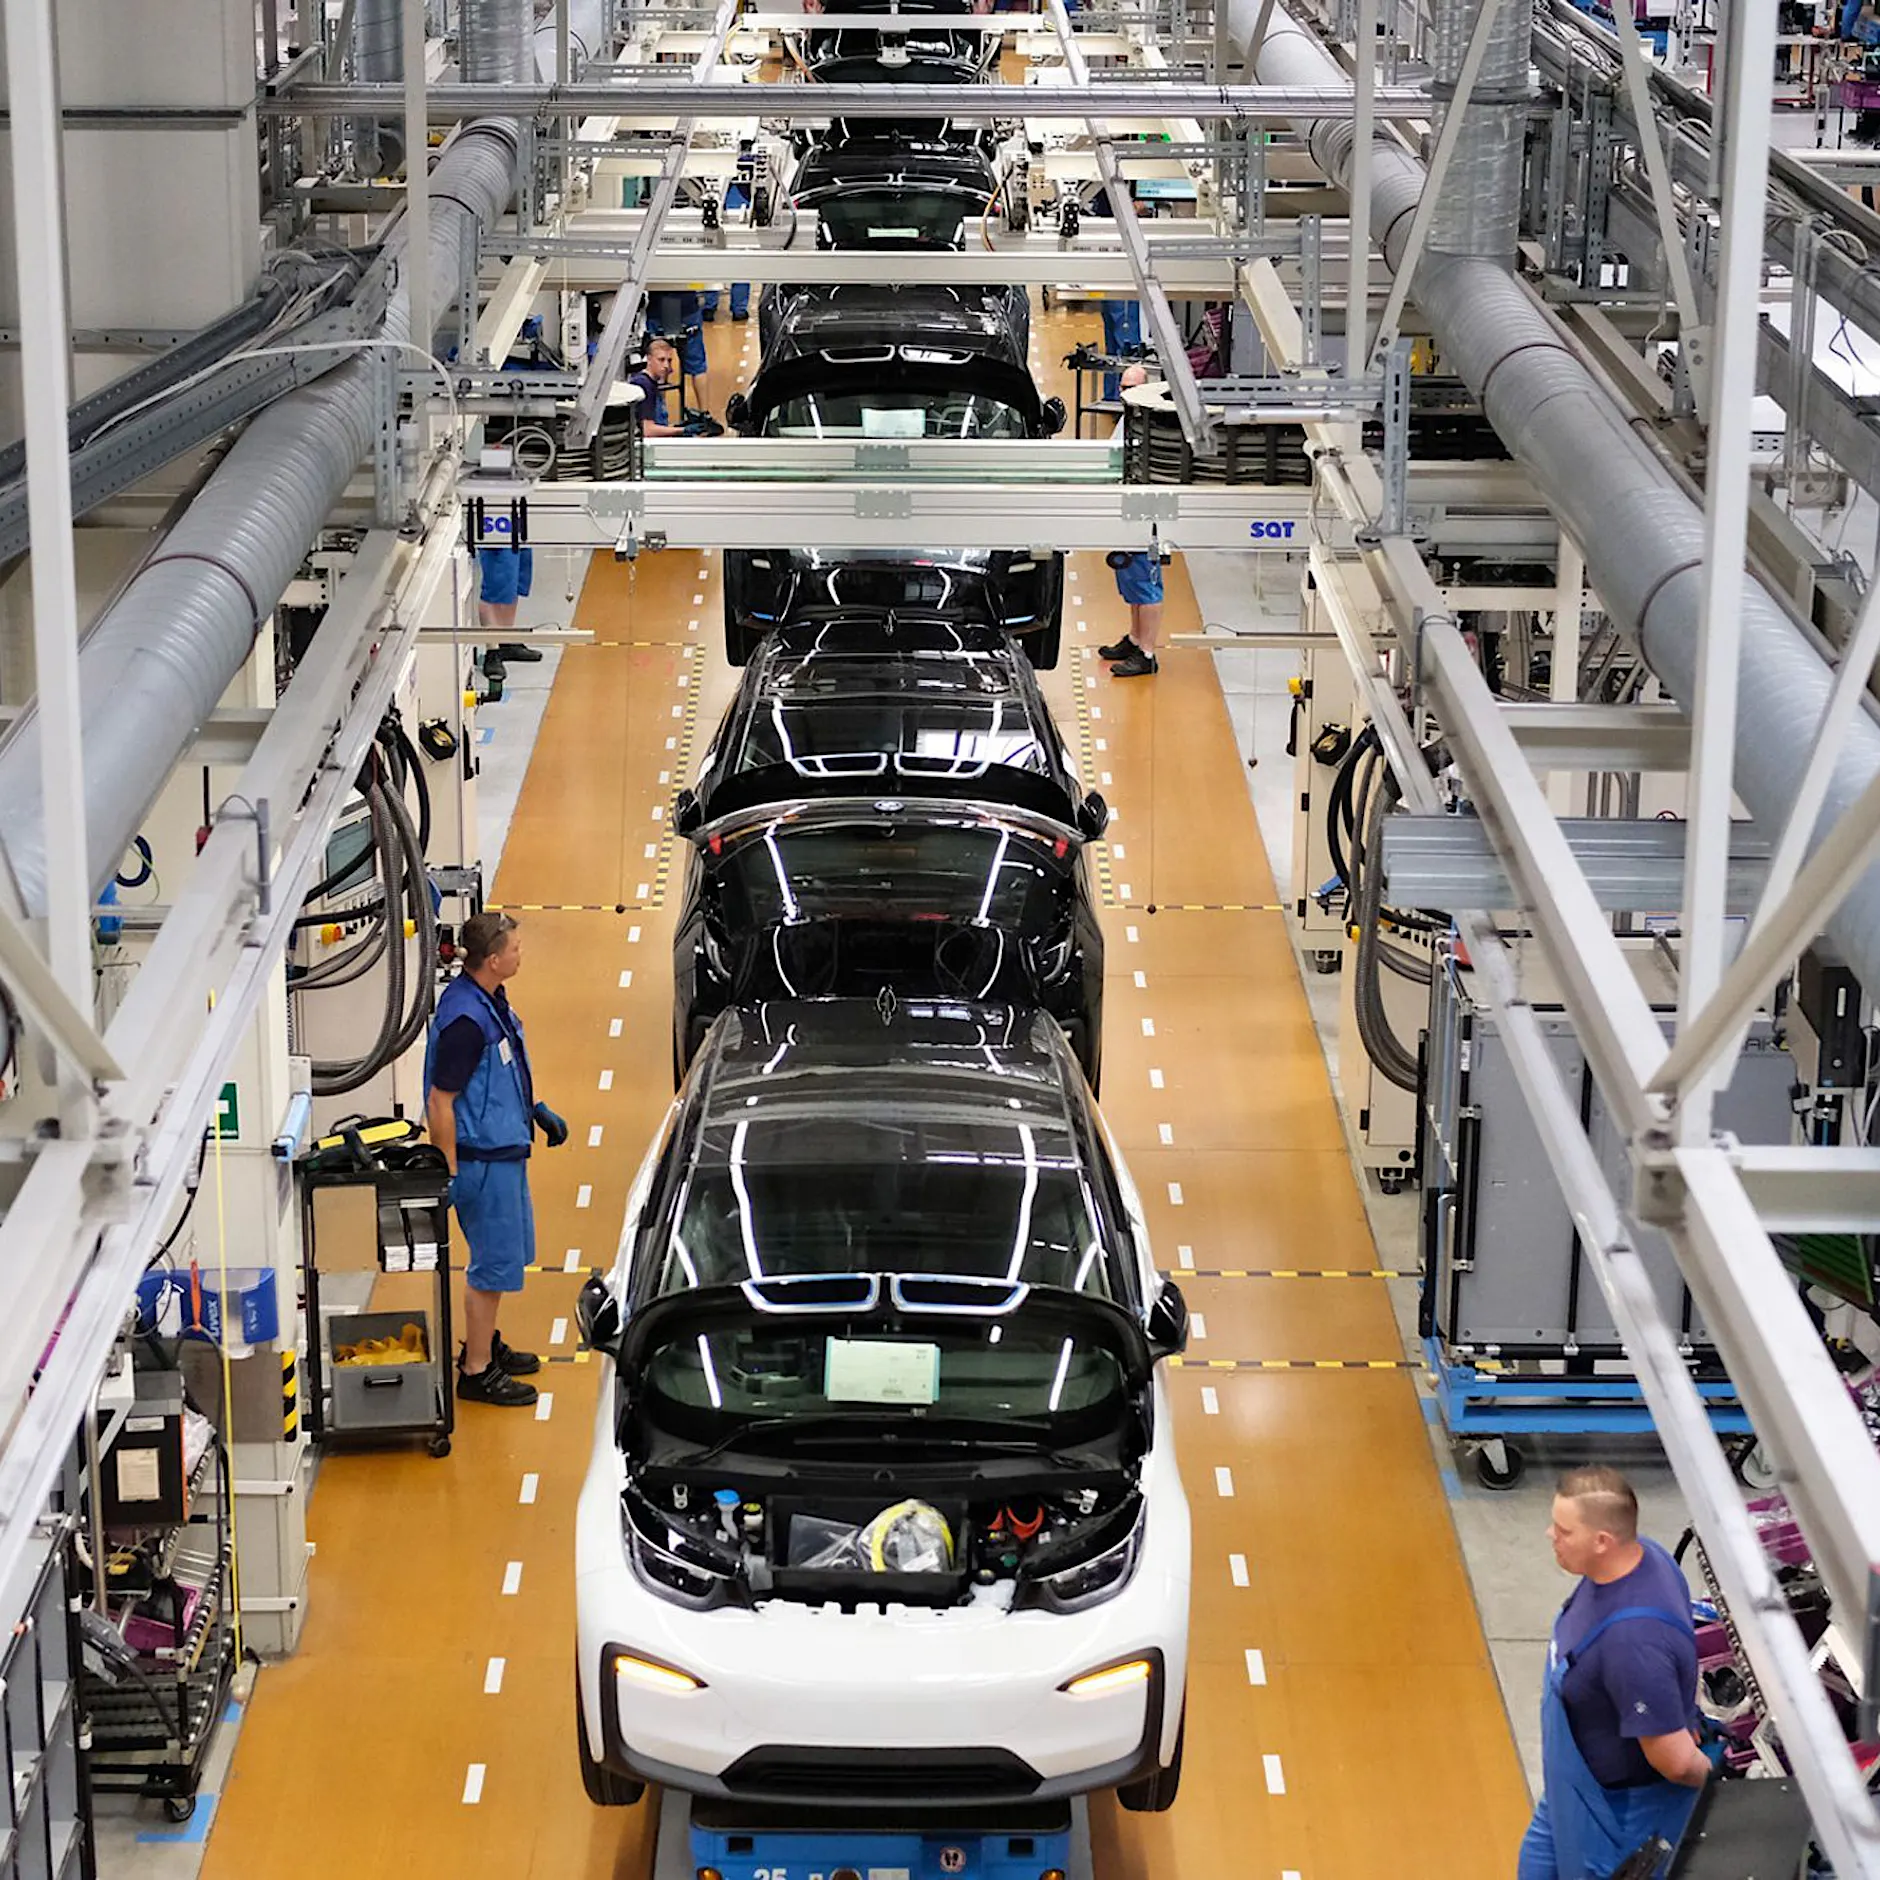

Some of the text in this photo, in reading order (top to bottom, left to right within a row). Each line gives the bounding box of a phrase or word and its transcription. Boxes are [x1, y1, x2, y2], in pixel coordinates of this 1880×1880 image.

[483, 516, 518, 534] SQ
[1250, 521, 1295, 538] SQT
[207, 1300, 220, 1337] uvex
